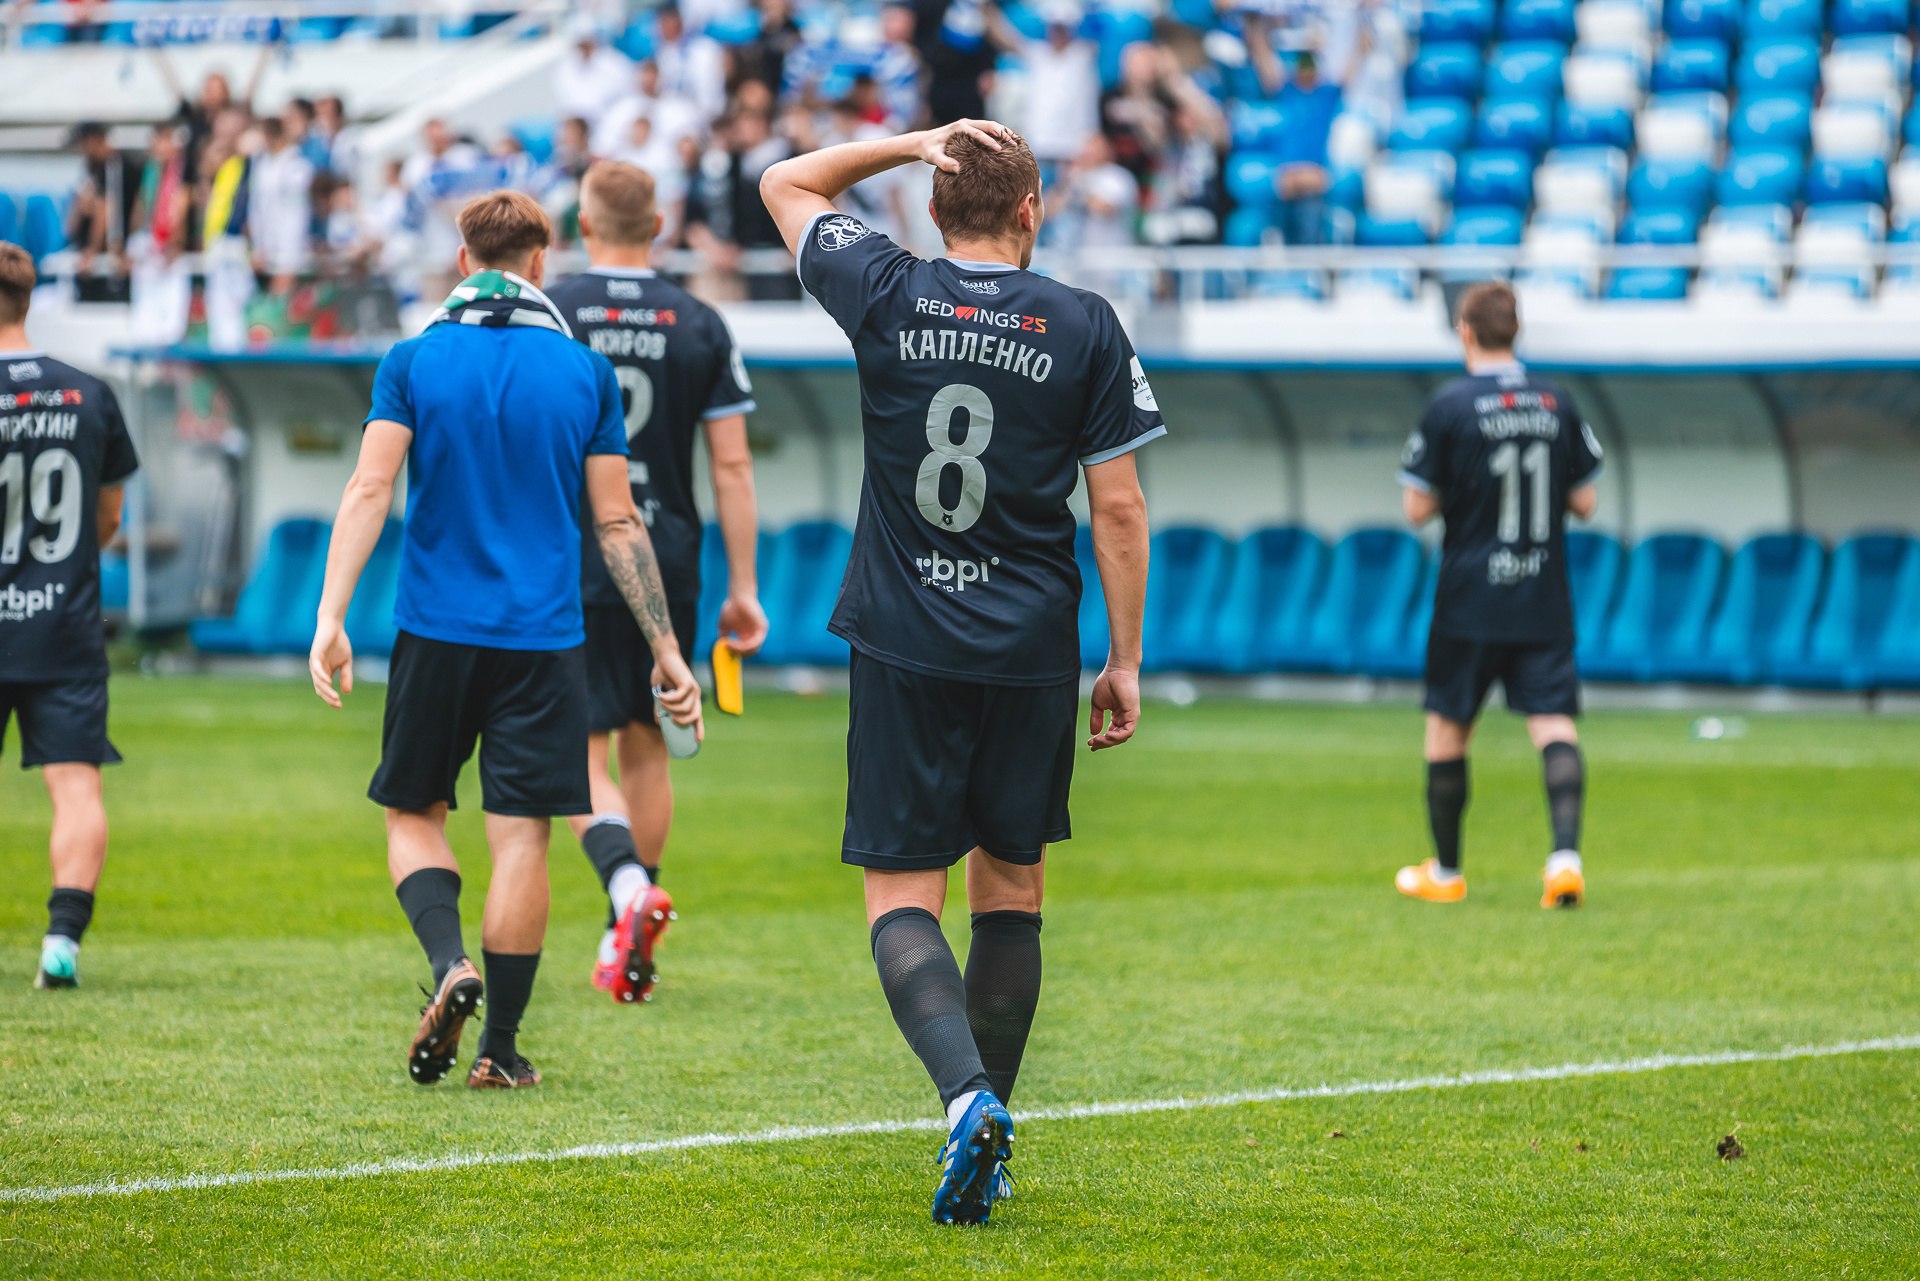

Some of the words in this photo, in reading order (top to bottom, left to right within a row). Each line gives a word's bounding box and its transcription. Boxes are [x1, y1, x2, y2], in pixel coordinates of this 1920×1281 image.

[899, 329, 1053, 383] КАПЛЕНКО
[915, 383, 994, 533] 8
[1488, 440, 1551, 543] 11
[0, 447, 82, 564] 19
[916, 550, 993, 591] rbpi
[920, 577, 954, 593] grop
